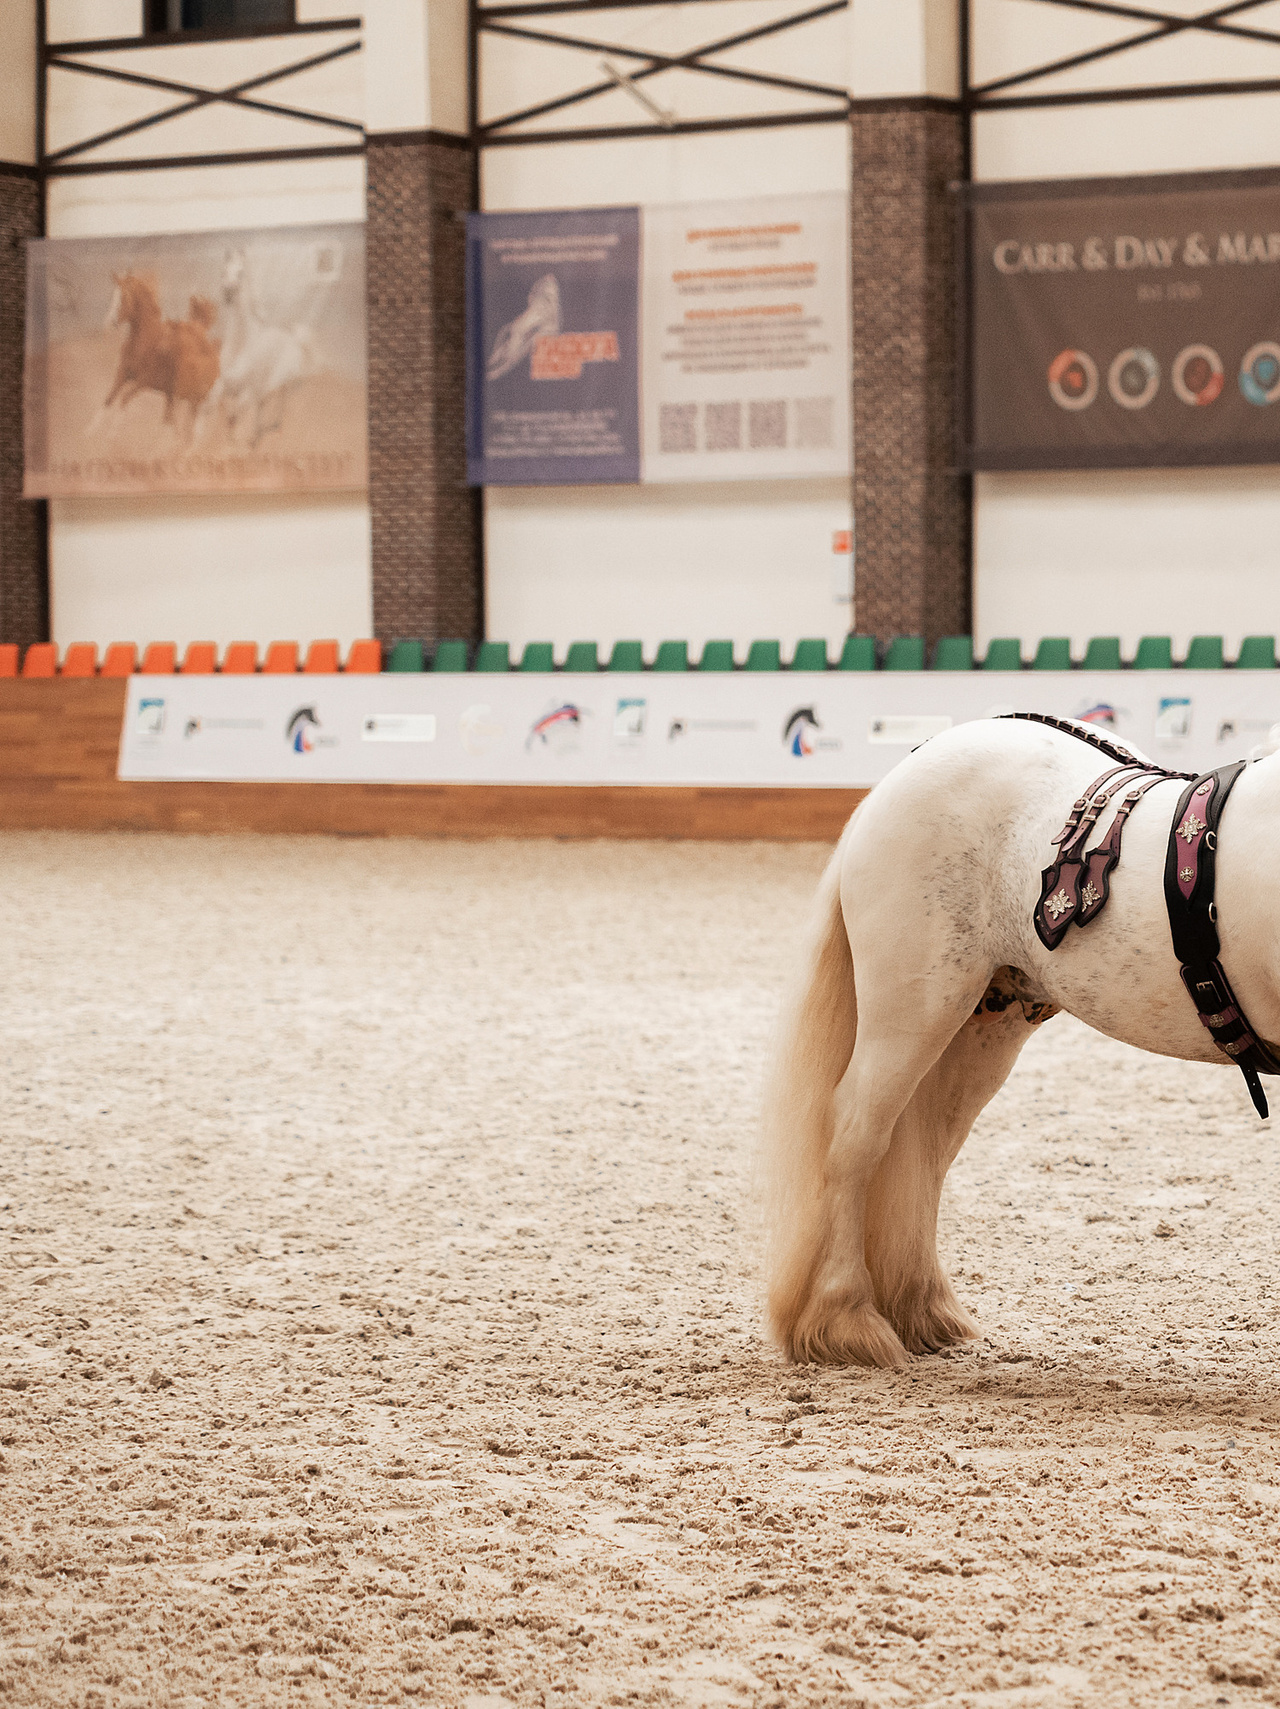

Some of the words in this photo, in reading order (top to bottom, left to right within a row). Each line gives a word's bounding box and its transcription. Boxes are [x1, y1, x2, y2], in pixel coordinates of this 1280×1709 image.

[992, 239, 1078, 275] CARR
[1081, 236, 1108, 271] &
[1114, 235, 1178, 269] DAY
[1183, 232, 1210, 267] &
